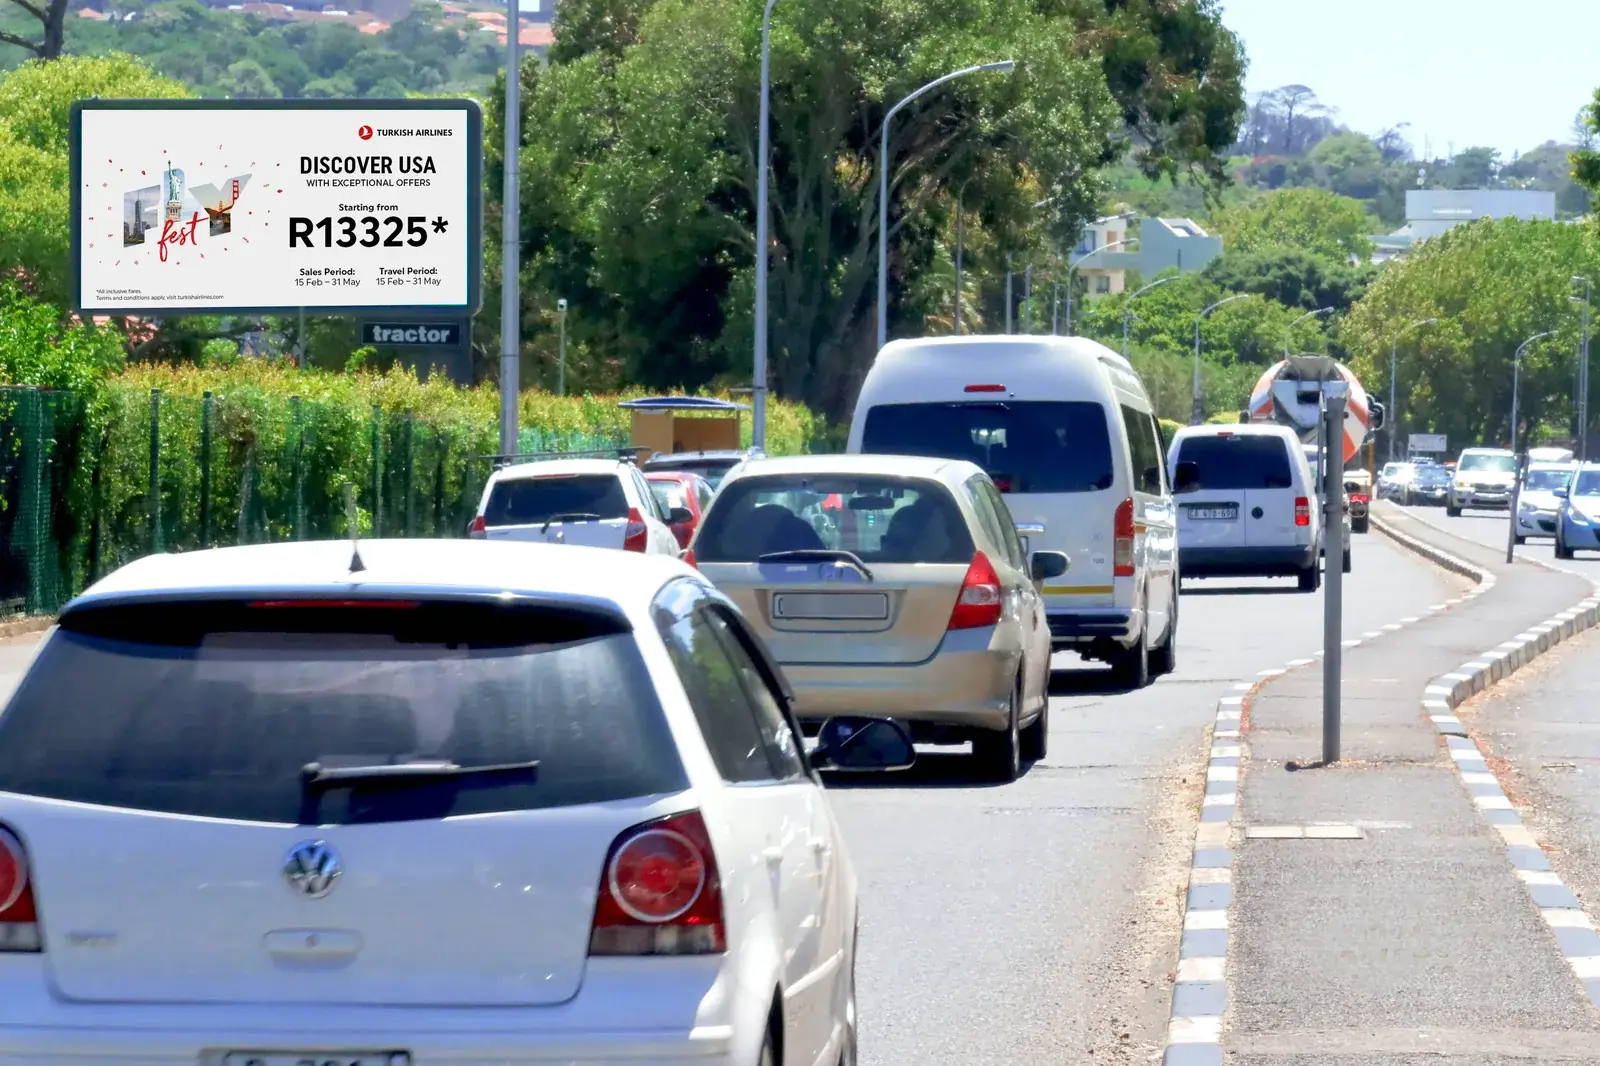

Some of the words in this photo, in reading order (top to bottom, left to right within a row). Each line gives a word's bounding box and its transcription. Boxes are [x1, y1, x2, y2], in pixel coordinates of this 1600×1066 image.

[376, 128, 414, 137] TURKISH
[415, 128, 453, 137] AIRLINES
[300, 156, 393, 174] DISCOVER
[398, 156, 437, 174] USA
[306, 178, 330, 187] WITH
[332, 178, 394, 187] EXCEPTIONAL
[396, 178, 431, 187] OFFERS
[338, 203, 375, 214] Starting
[376, 203, 399, 212] from
[157, 211, 209, 262] fest
[299, 268, 322, 276] Sales
[325, 268, 356, 277] Period:
[379, 267, 405, 275] Travel
[406, 266, 438, 275] Period:
[295, 278, 305, 287] 15
[307, 278, 324, 287] Feb
[332, 278, 341, 287] 31
[342, 278, 361, 289] May
[376, 277, 386, 287] 15
[388, 277, 405, 286] Feb
[412, 277, 422, 286] 31
[424, 277, 442, 289] May
[373, 325, 450, 343] tractor
